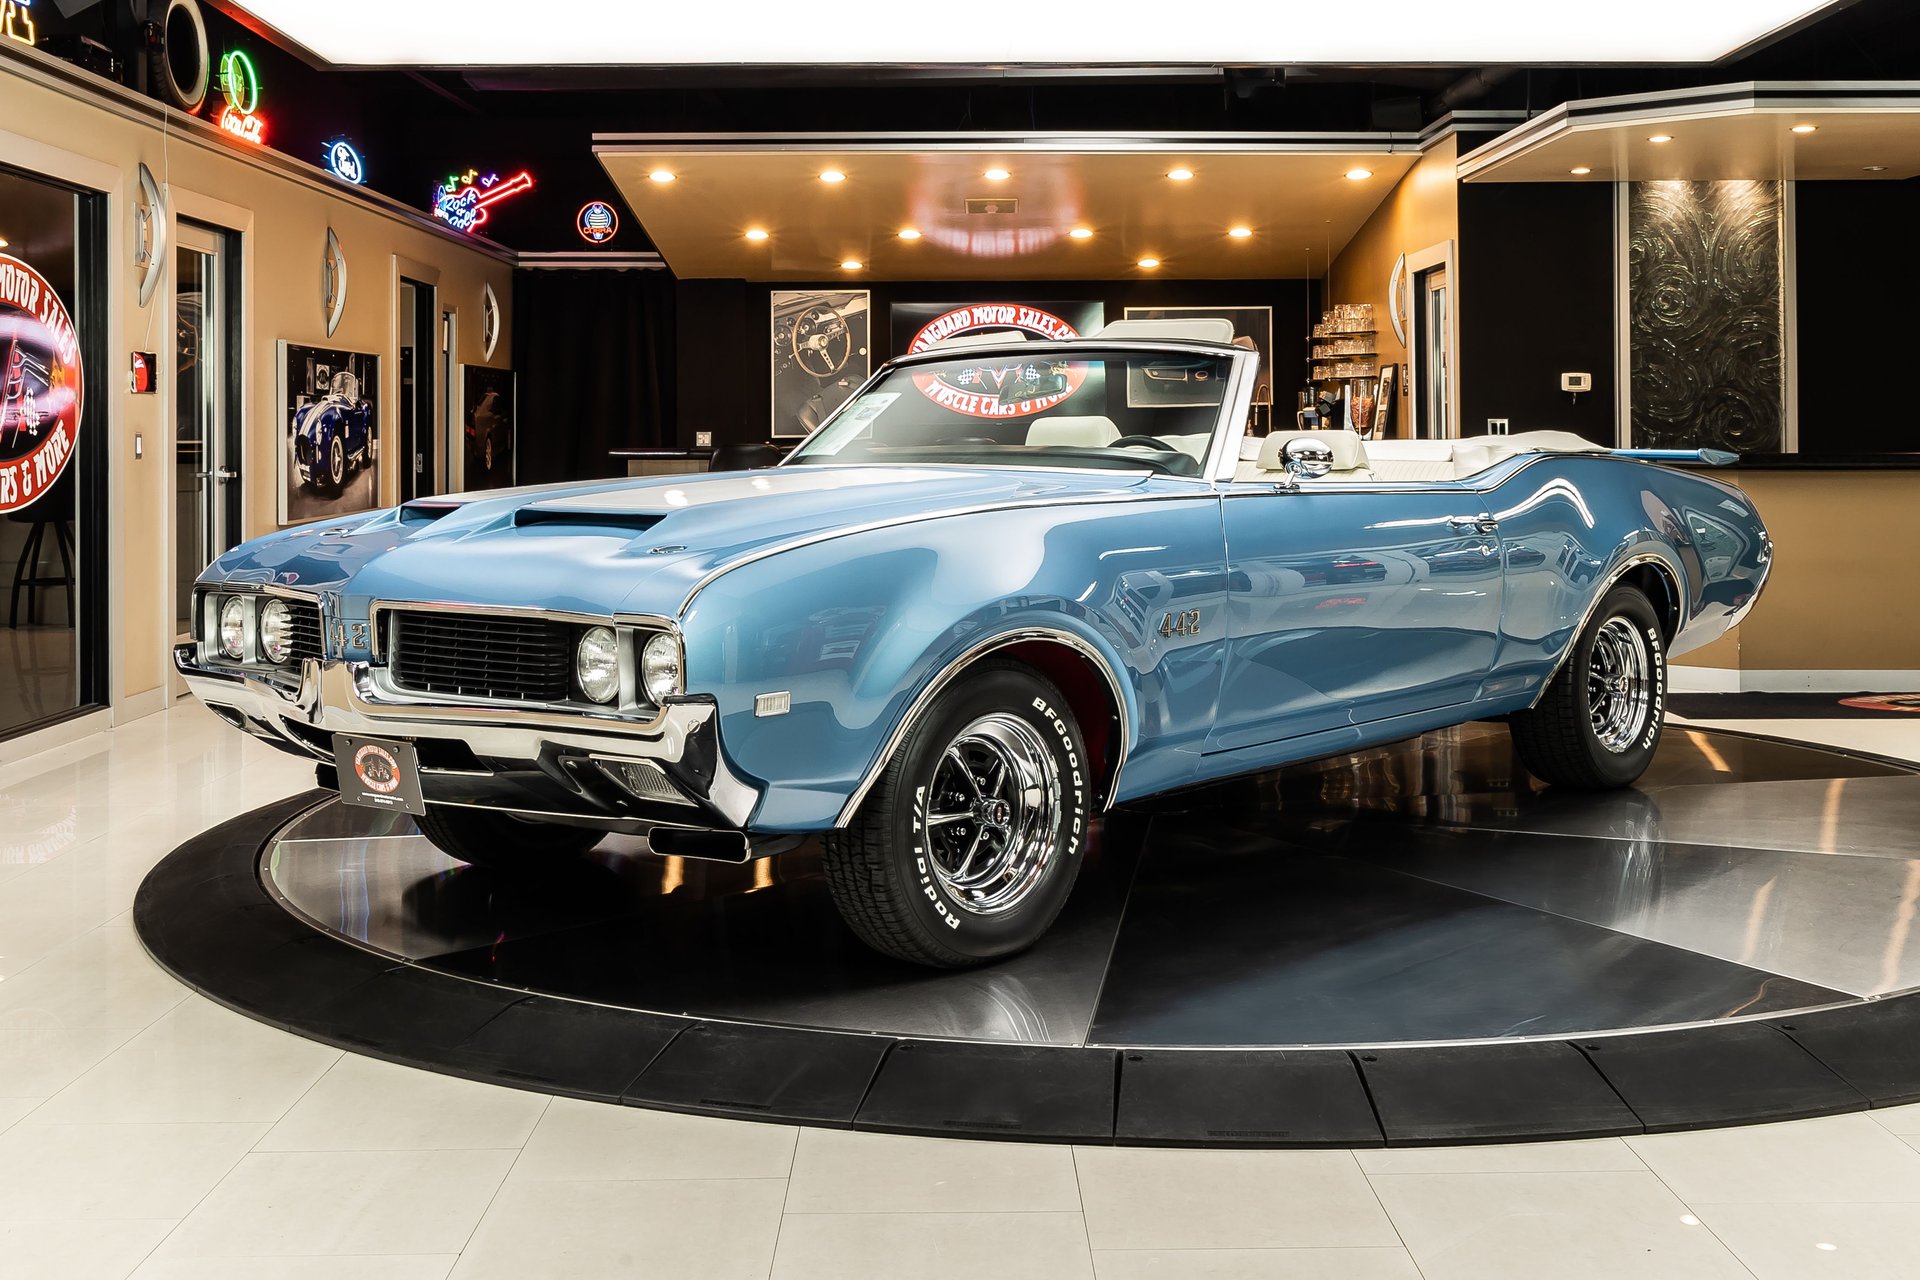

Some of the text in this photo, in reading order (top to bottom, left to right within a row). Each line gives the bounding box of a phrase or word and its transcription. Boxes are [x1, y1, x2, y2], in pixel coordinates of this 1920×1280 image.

[444, 189, 477, 212] Rock
[583, 226, 613, 234] COBRA
[40, 290, 77, 365] SALES
[971, 306, 1016, 325] MOTOR
[924, 380, 979, 413] MUSCLE
[21, 459, 32, 497] &
[33, 419, 70, 488] MORE
[1158, 609, 1200, 638] 442
[1642, 627, 1663, 750] BFGoodrich
[1032, 696, 1084, 855] BFGoodrich
[913, 785, 961, 930] Radial T/A
